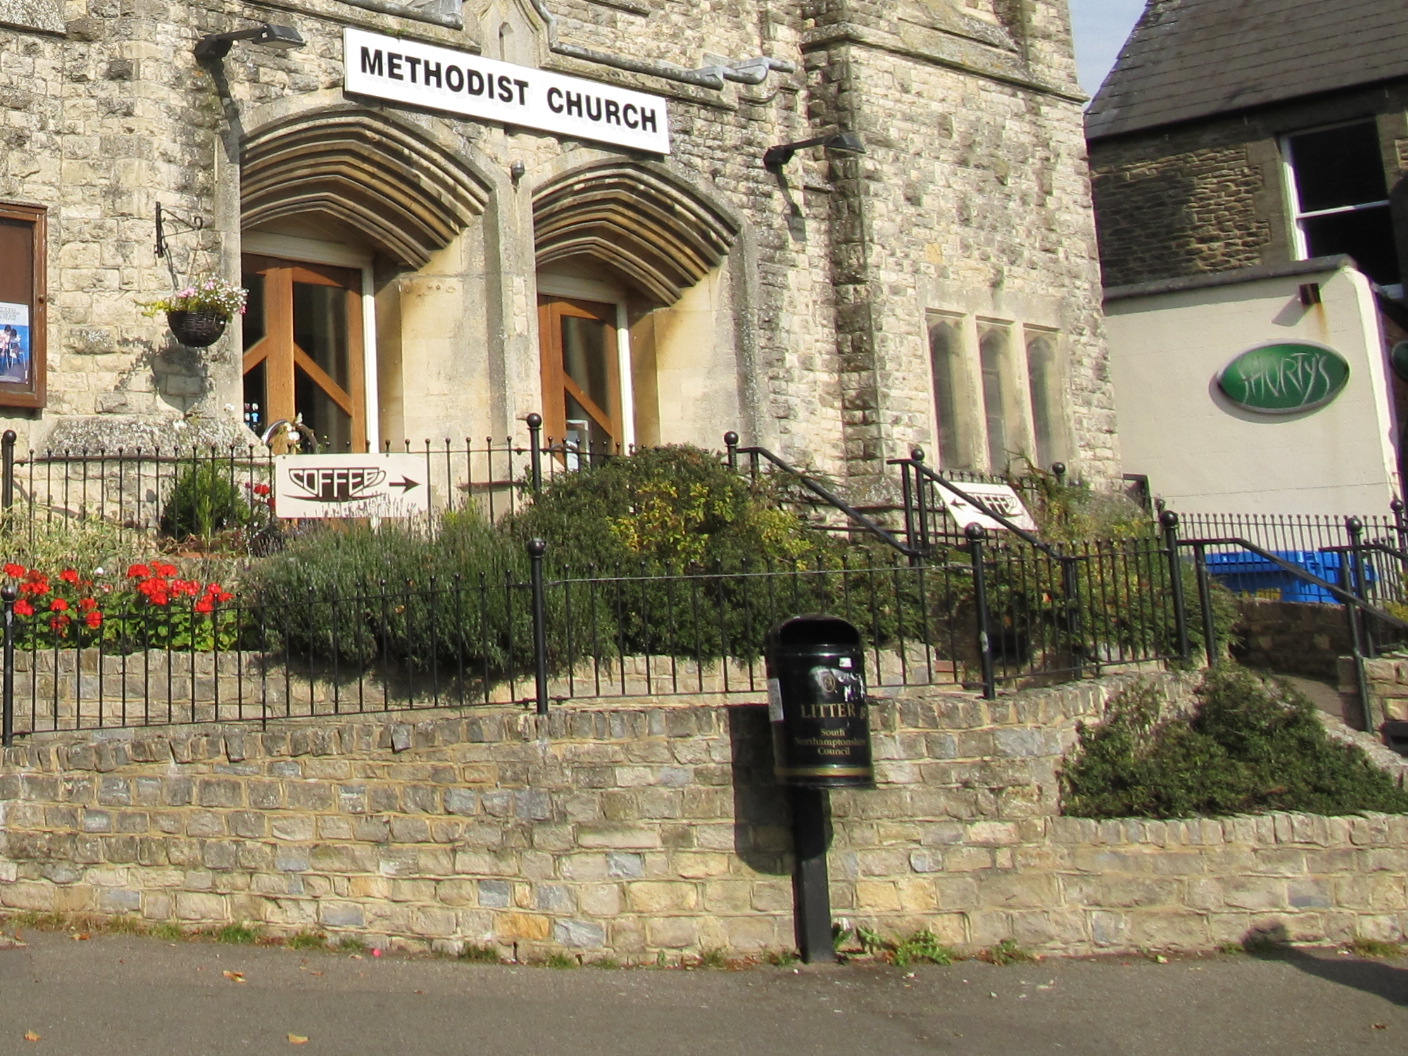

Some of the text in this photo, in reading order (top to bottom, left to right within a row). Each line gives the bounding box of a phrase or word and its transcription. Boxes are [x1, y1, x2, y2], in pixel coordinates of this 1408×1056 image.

[360, 46, 658, 133] METHODIST CHURCH
[289, 468, 383, 498] COFFEE
[801, 703, 856, 719] LITTER
[820, 728, 846, 737] South
[817, 746, 851, 755] Council
